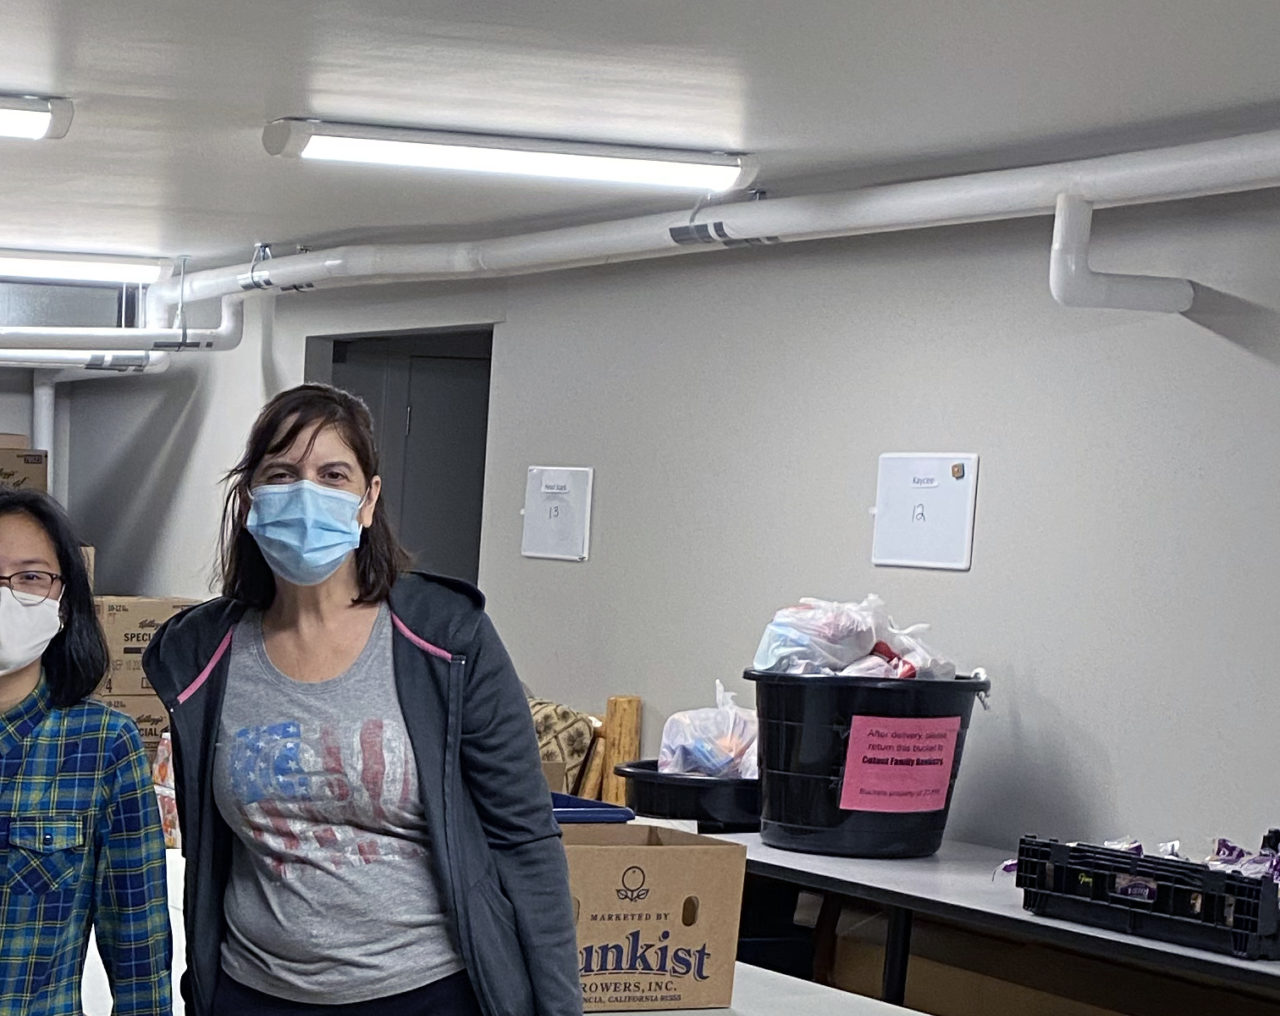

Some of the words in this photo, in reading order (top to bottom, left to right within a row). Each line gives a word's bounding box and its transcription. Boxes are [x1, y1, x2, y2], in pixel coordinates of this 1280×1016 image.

[549, 505, 560, 519] 13
[912, 503, 926, 523] 12
[123, 632, 152, 642] SPECI
[139, 727, 160, 737] CIAL
[590, 912, 652, 922] MARKETED
[656, 912, 671, 921] BY
[578, 929, 712, 982] unkist
[581, 981, 645, 994] ROWERS,
[648, 980, 678, 992] INC.
[607, 994, 659, 1003] CALIFORNIA
